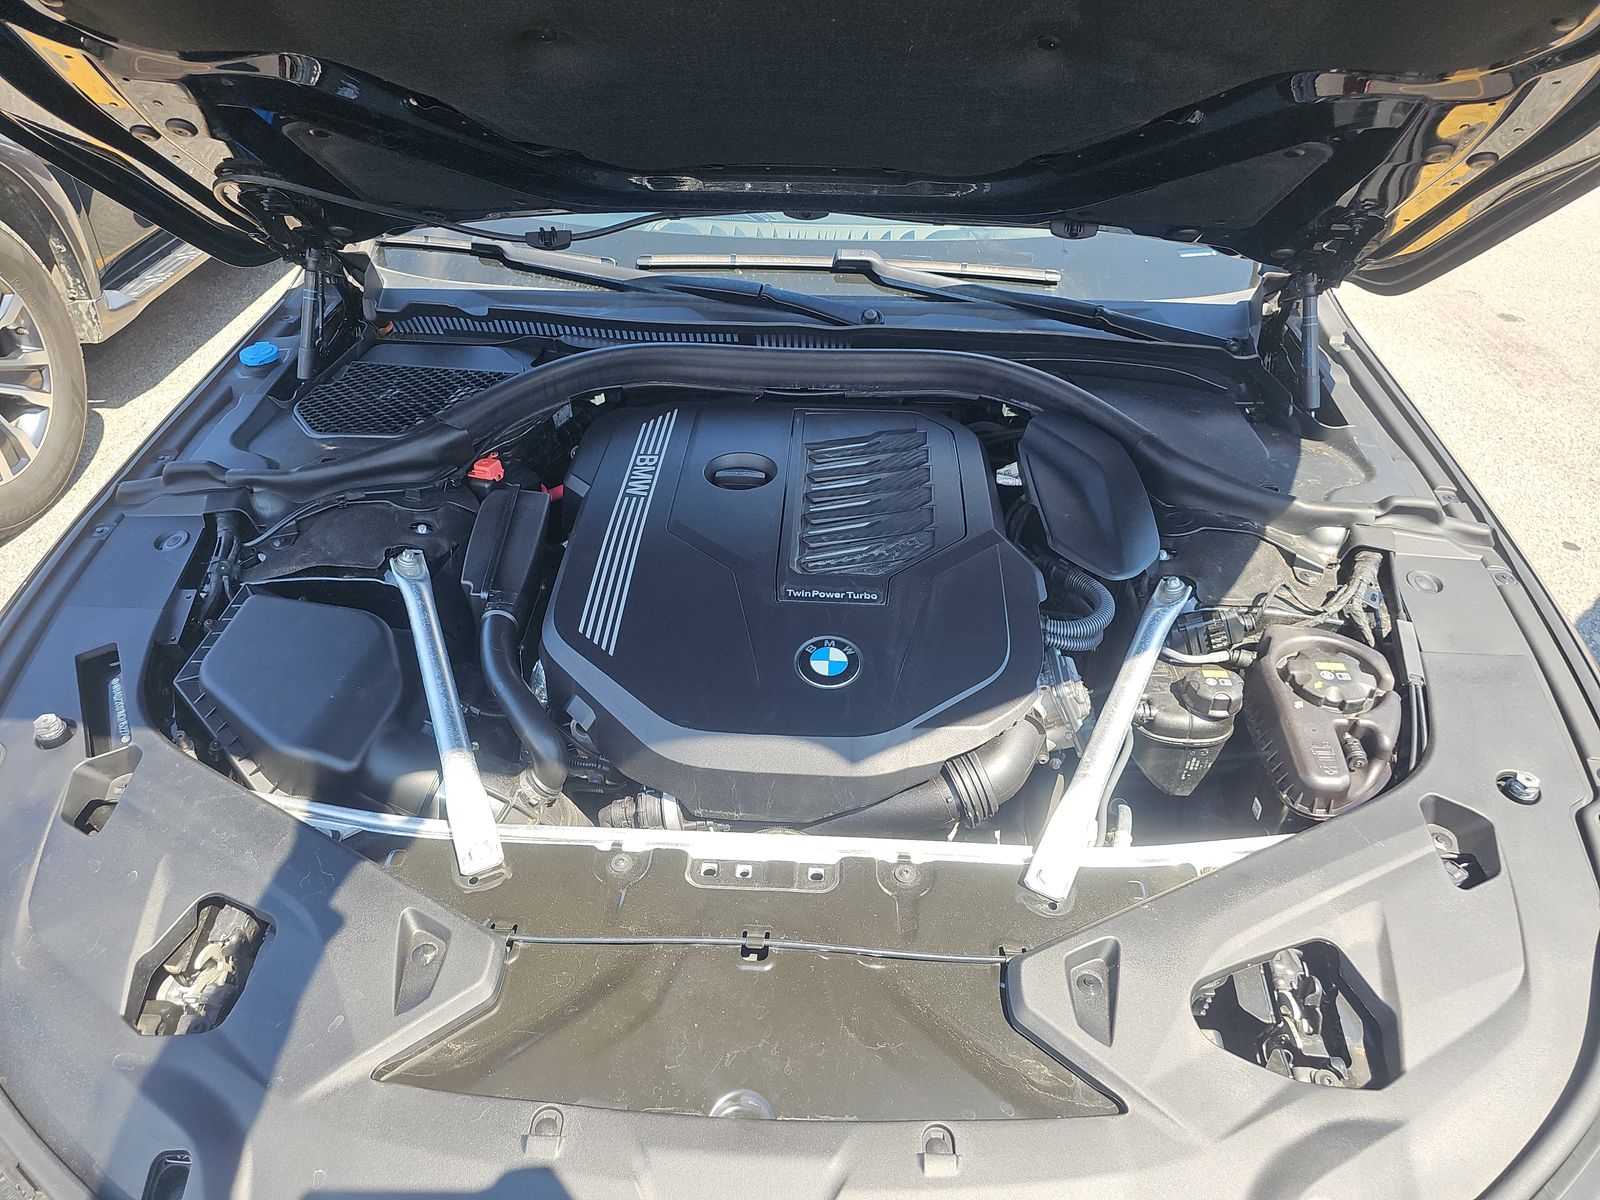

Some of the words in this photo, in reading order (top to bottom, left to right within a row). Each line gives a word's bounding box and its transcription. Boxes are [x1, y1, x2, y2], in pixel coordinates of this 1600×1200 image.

[625, 455, 659, 496] BMW
[846, 591, 878, 600] Turbo
[805, 639, 855, 655] BMW
